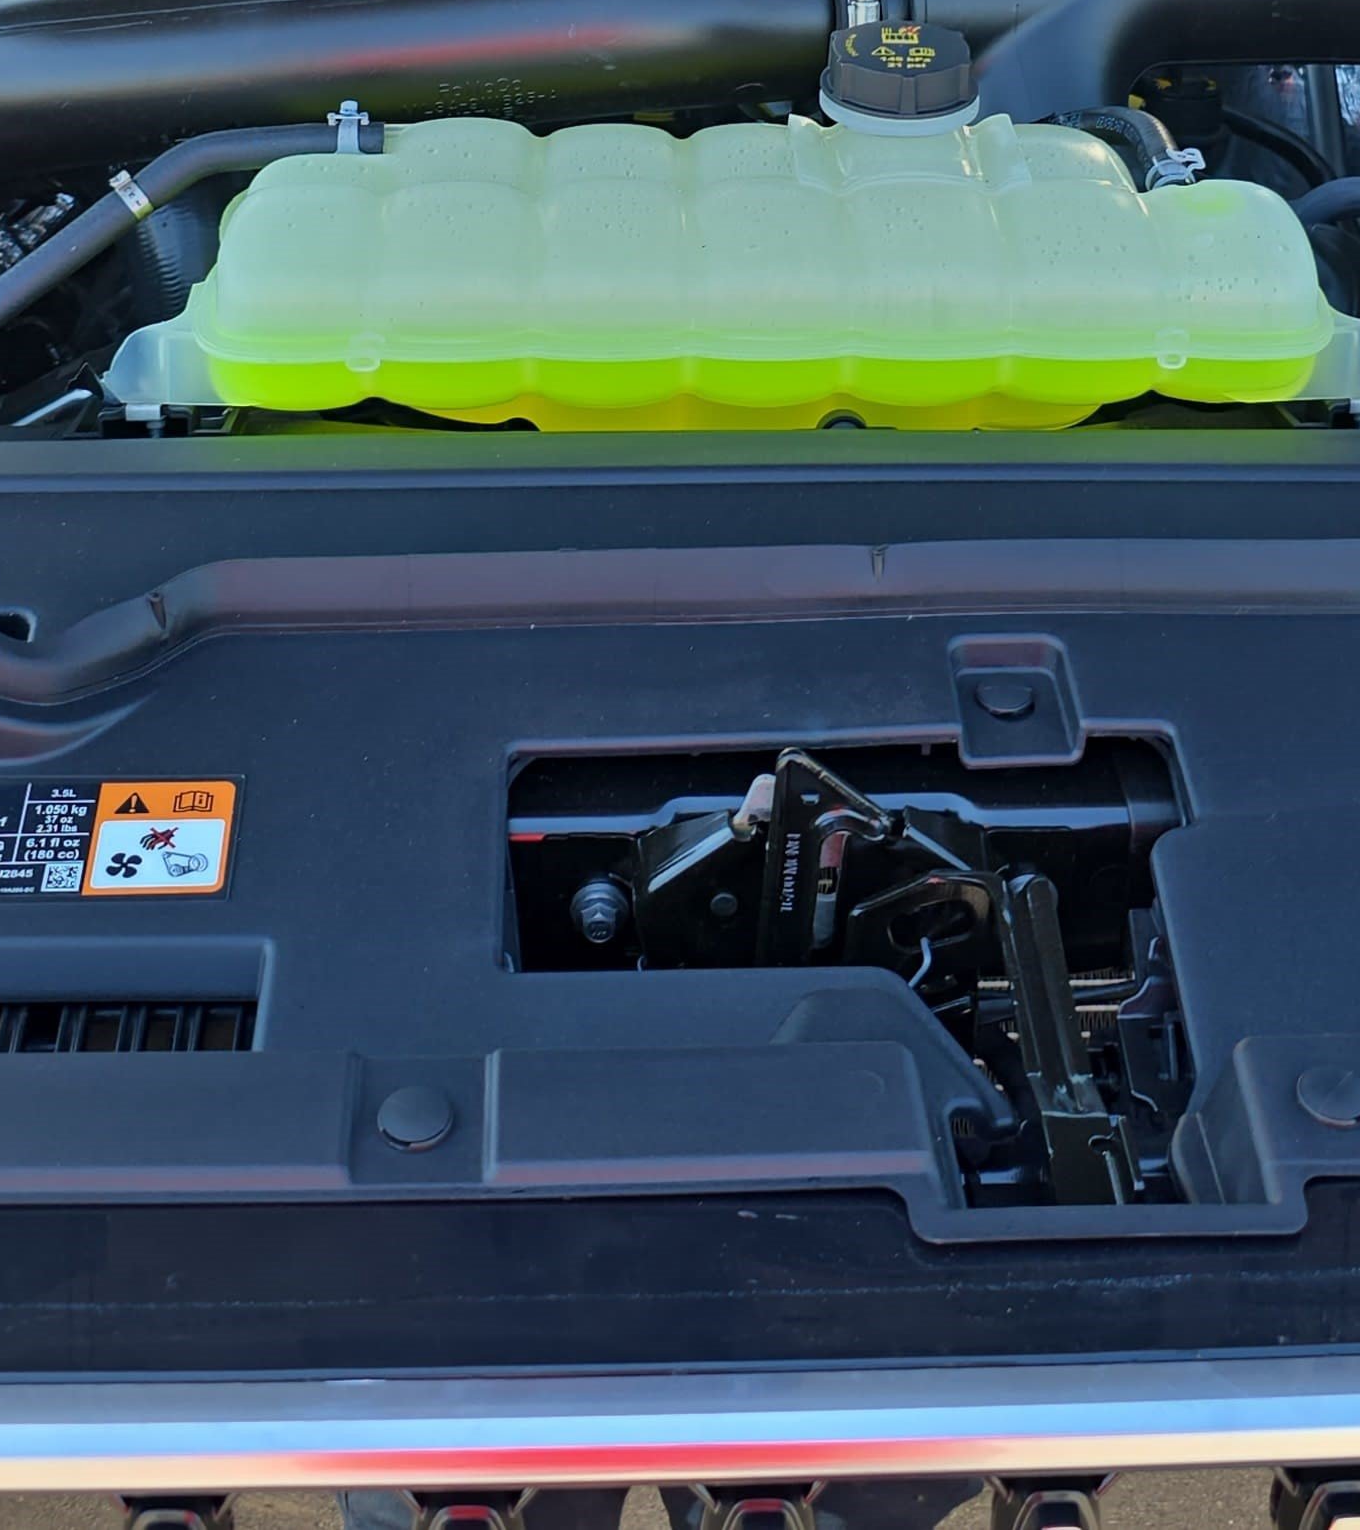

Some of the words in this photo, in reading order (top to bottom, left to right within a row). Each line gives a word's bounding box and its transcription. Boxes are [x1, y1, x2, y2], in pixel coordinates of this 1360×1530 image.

[35, 804, 68, 815] 1.050
[71, 804, 87, 817] kg
[44, 815, 58, 824] 37
[60, 816, 74, 824] oz
[36, 824, 58, 833] 2.31
[26, 838, 46, 848] 6.1
[63, 839, 80, 848] oz
[57, 849, 80, 860] cc)
